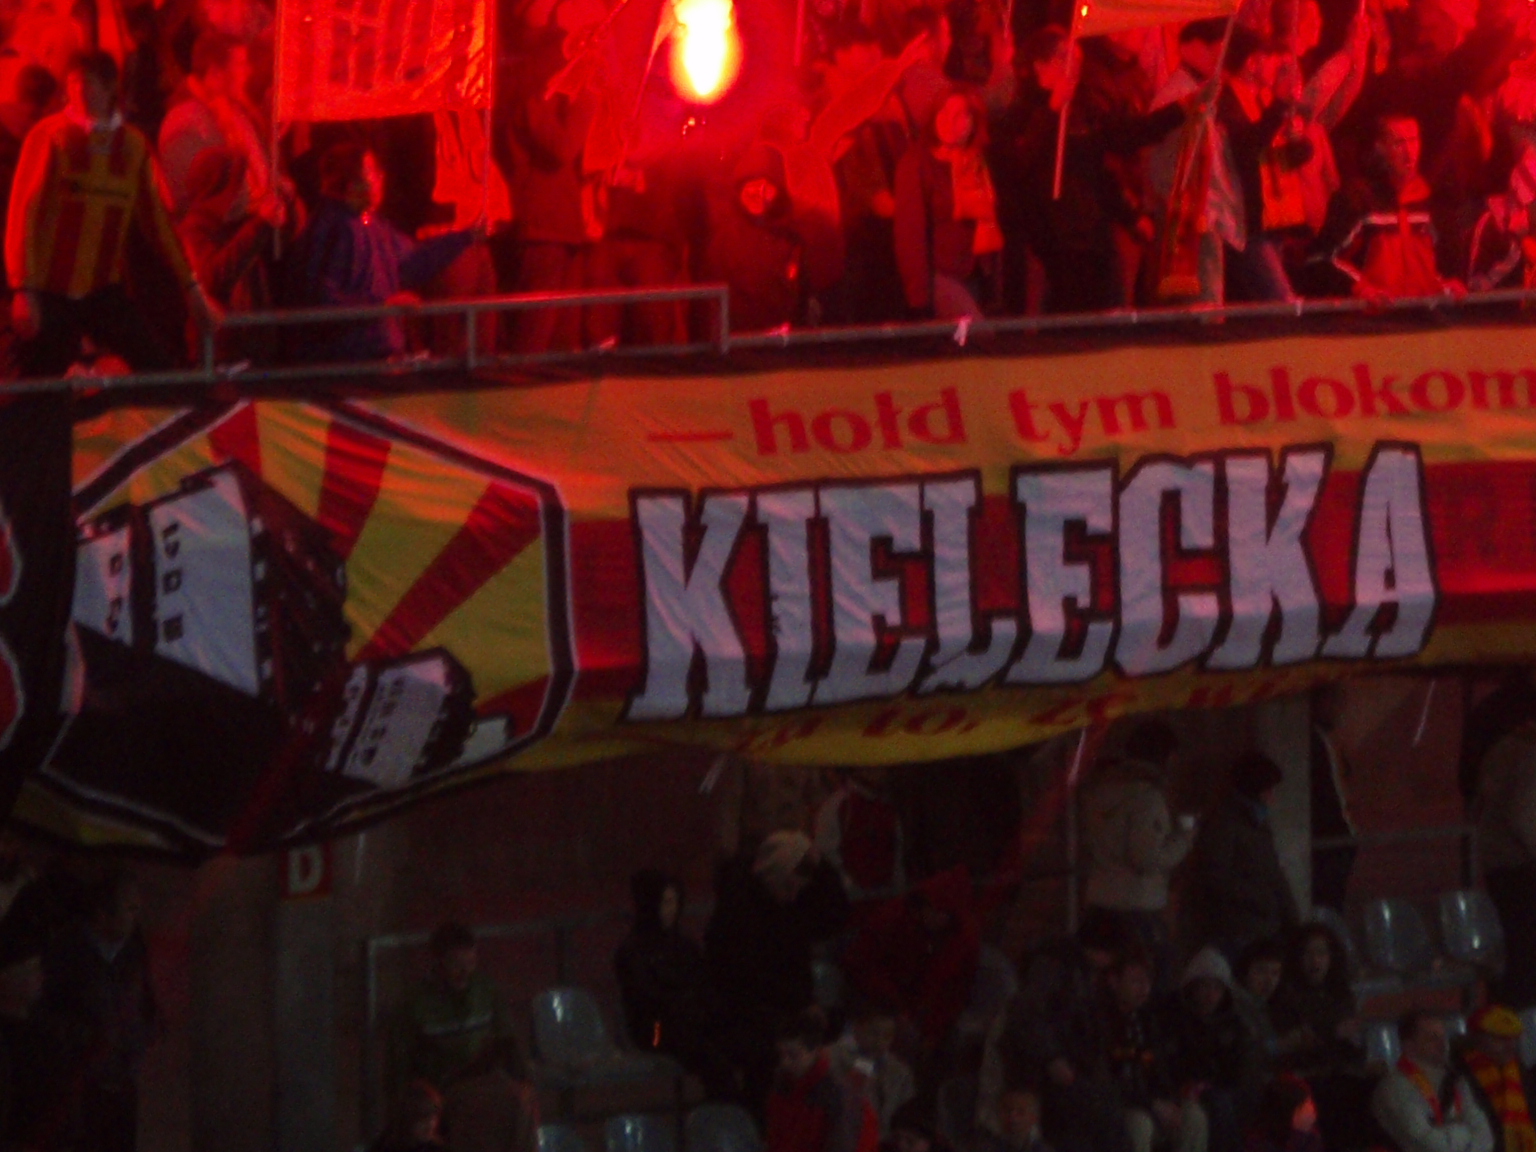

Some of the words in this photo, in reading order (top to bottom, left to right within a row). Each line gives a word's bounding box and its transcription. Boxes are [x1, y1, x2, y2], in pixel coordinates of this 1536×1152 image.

[748, 387, 967, 456] hołd
[1009, 387, 1175, 455] tym
[625, 441, 1440, 722] KIELECKA
